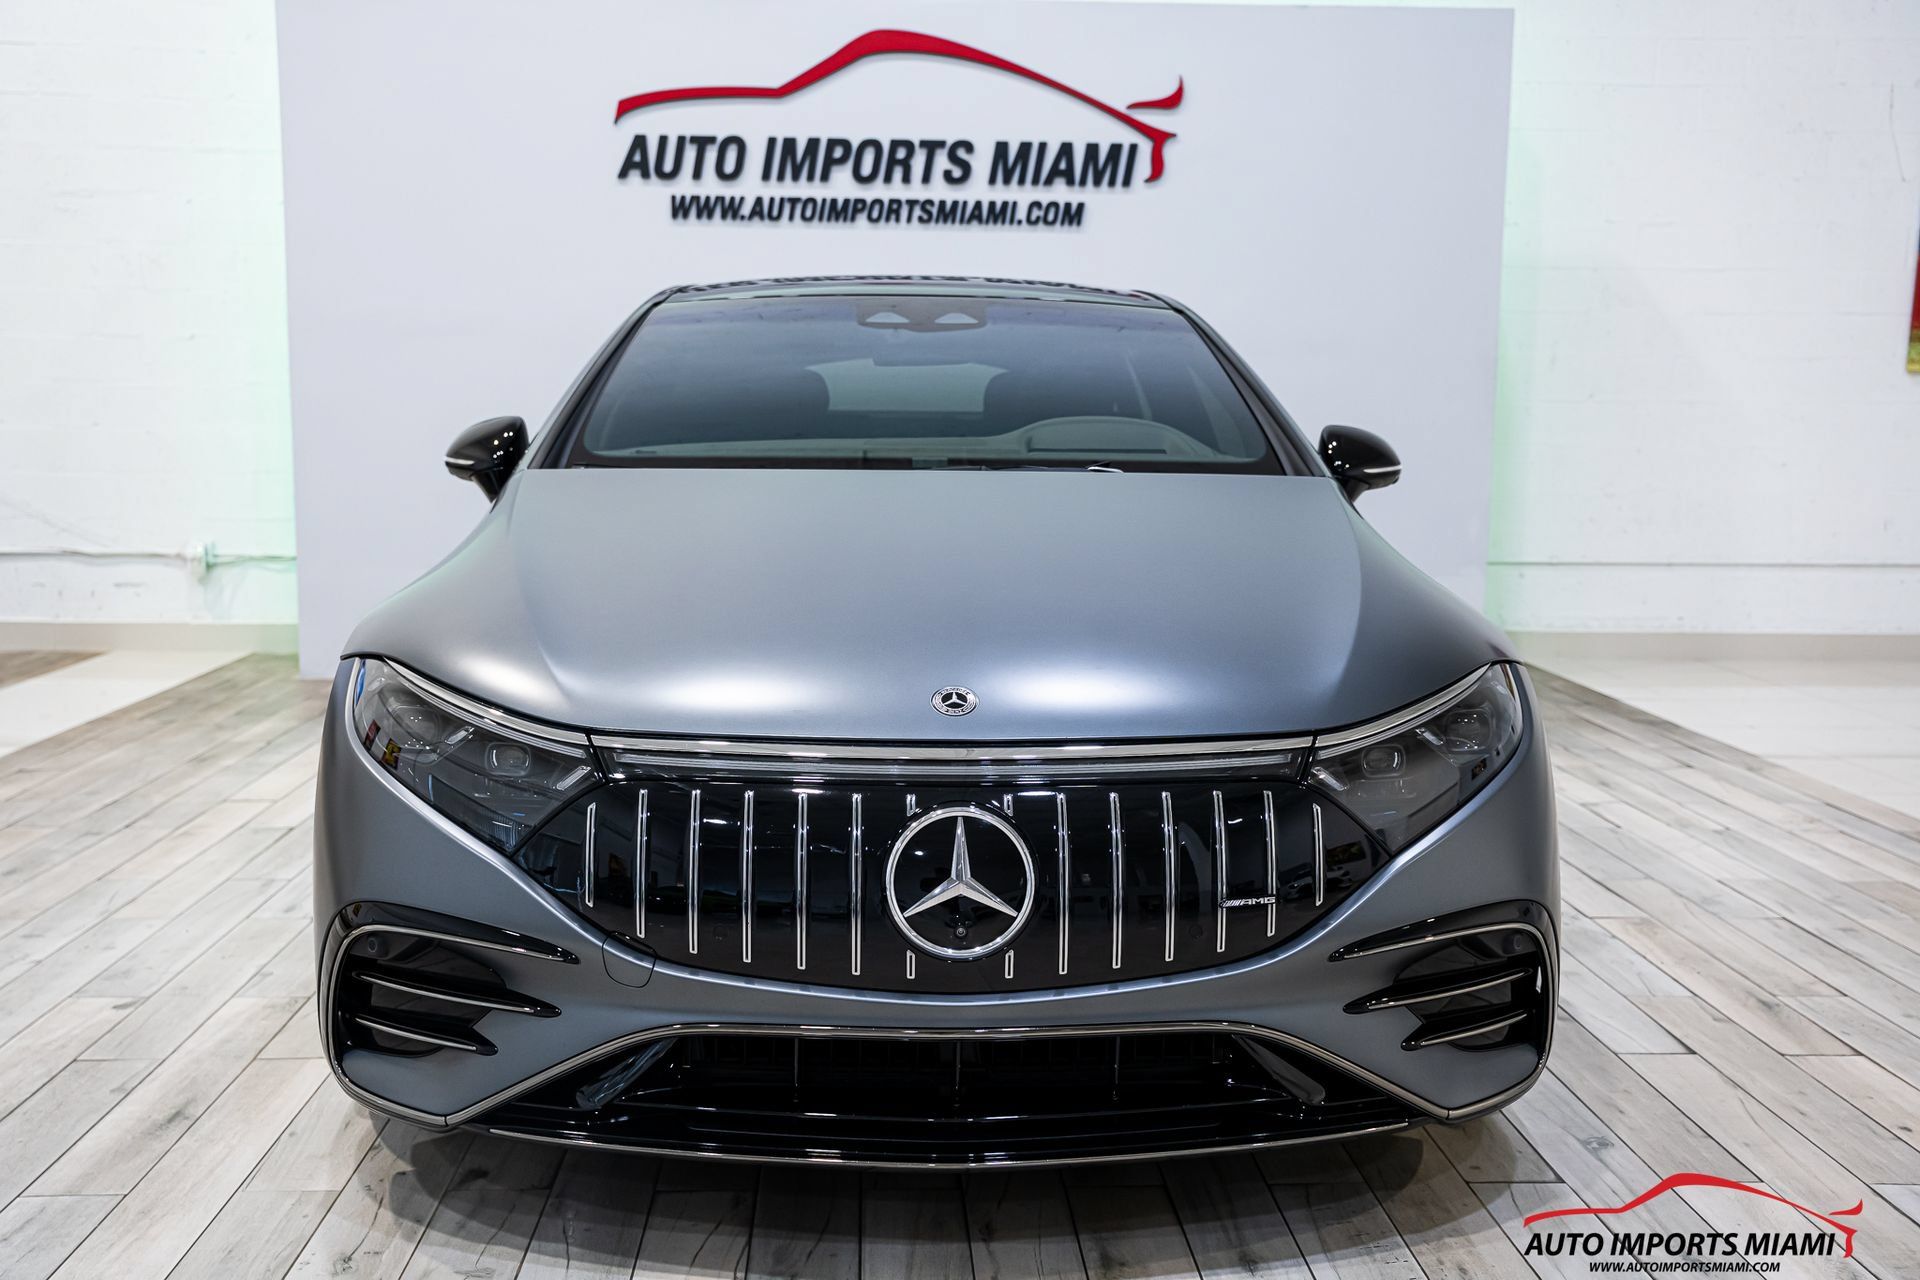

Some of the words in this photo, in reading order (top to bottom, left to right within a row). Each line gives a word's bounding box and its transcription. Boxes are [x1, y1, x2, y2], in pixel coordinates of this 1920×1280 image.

[617, 133, 747, 181] AUTO
[761, 137, 975, 185] IMPORTS
[988, 141, 1138, 187] MIAMI
[670, 195, 1085, 226] WWW.AUTOIMPORTSMIAMI.COM
